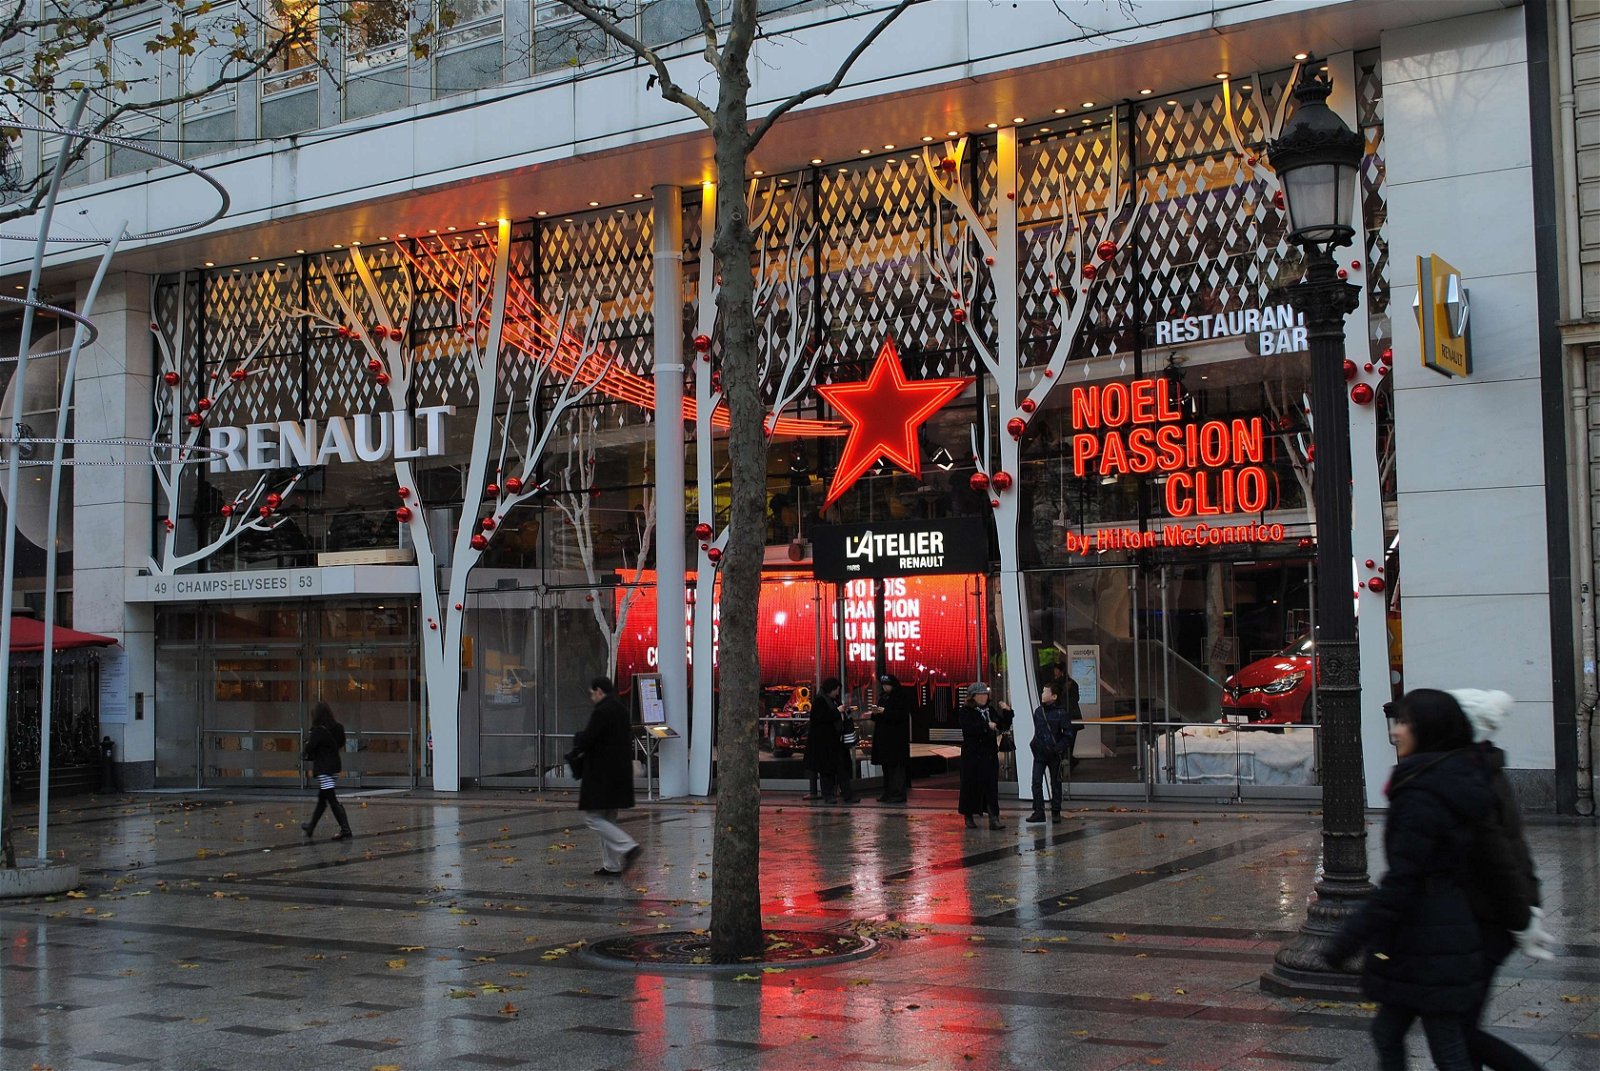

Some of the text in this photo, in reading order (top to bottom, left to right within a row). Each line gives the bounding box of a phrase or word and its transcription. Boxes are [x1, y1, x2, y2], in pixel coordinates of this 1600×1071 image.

[1259, 327, 1309, 356] BAR
[1441, 343, 1463, 366] RENAULT
[1072, 377, 1182, 430] NOEL
[209, 405, 457, 473] RENAULT
[1073, 416, 1263, 477] PASSION
[1165, 466, 1268, 518] CLIO
[1066, 521, 1284, 555] by Hilton McConnico
[900, 556, 945, 569] RENAULT
[154, 575, 313, 594] 49 CHAMPS-ELYSEES 53
[861, 620, 921, 640] MNDE
[849, 642, 906, 662] PILTE
